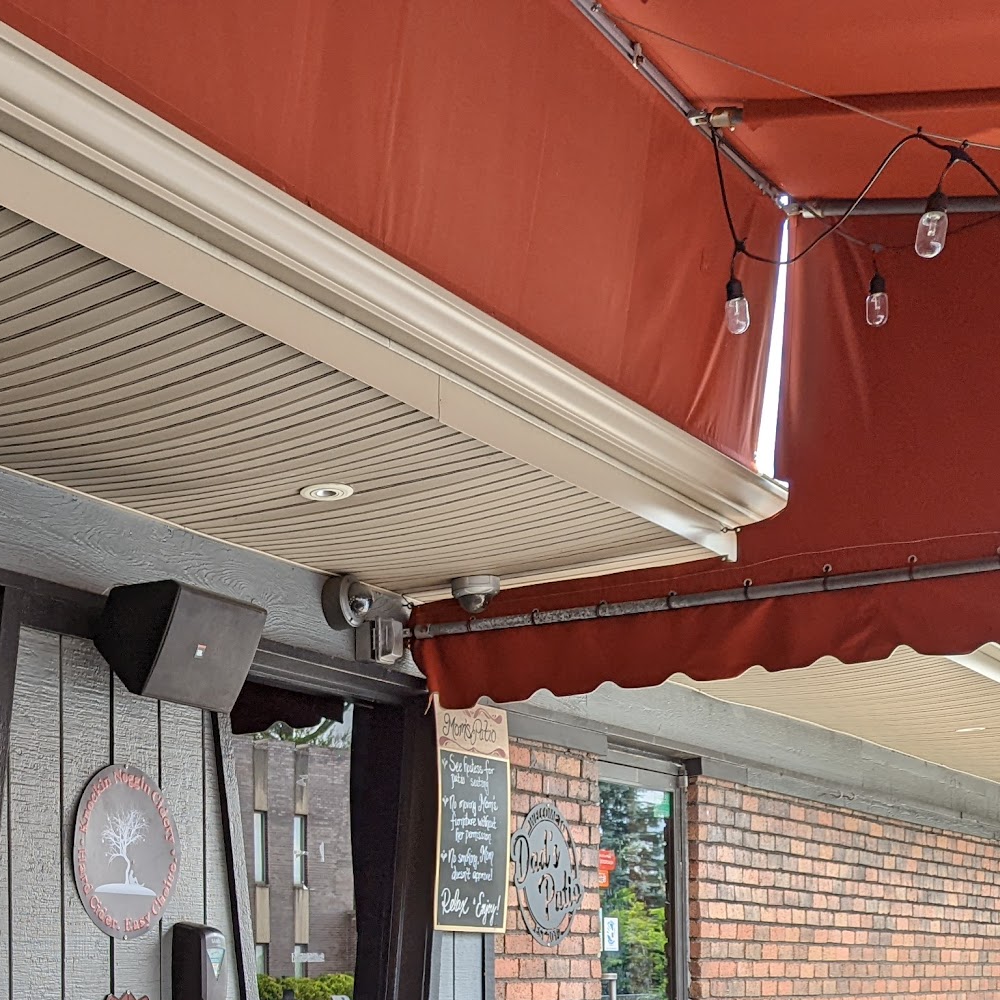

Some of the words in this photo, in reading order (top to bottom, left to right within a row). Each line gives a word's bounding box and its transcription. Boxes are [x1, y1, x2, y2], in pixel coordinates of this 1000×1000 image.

[471, 718, 497, 745] Patio
[449, 753, 462, 772] See
[113, 768, 151, 795] Noggin
[151, 790, 175, 843] Cidery
[513, 830, 560, 884] Dad's
[77, 849, 94, 895] Hard
[124, 913, 151, 932] Easy
[441, 887, 470, 918] Relax
[475, 891, 502, 927] Enjoy!
[538, 870, 582, 921] Patio
